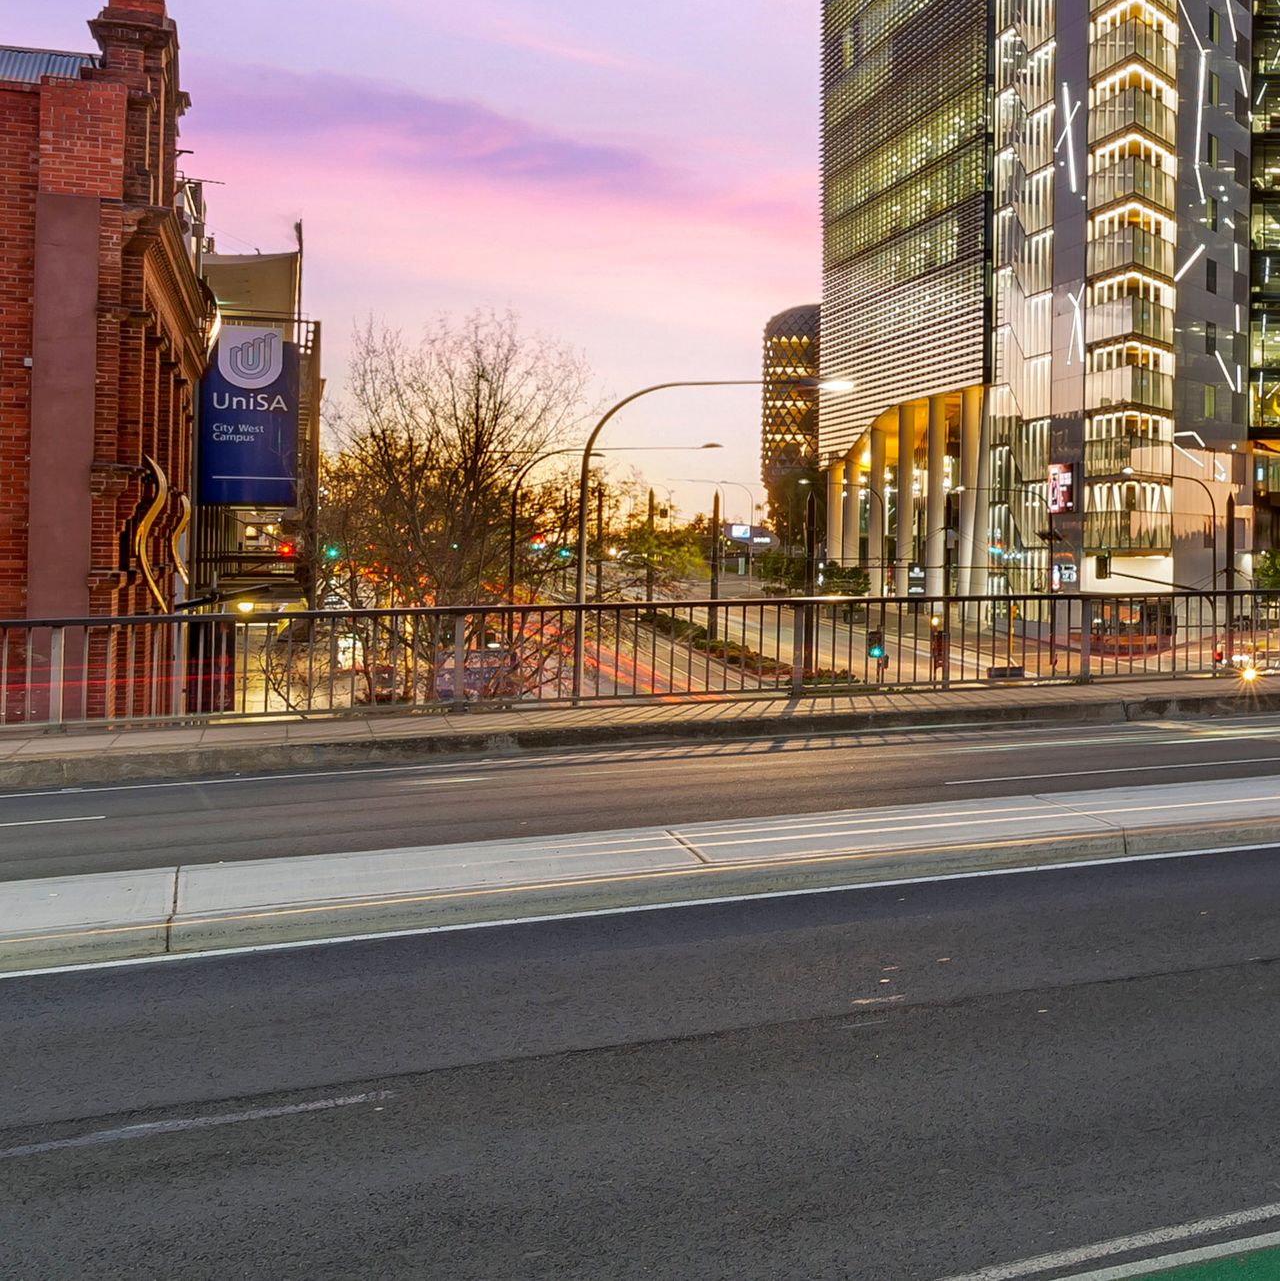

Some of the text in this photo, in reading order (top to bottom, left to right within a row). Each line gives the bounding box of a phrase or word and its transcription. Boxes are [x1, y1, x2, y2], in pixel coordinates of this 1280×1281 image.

[212, 392, 288, 412] UniSA
[212, 423, 264, 434] City West
[212, 432, 255, 443] Campus
